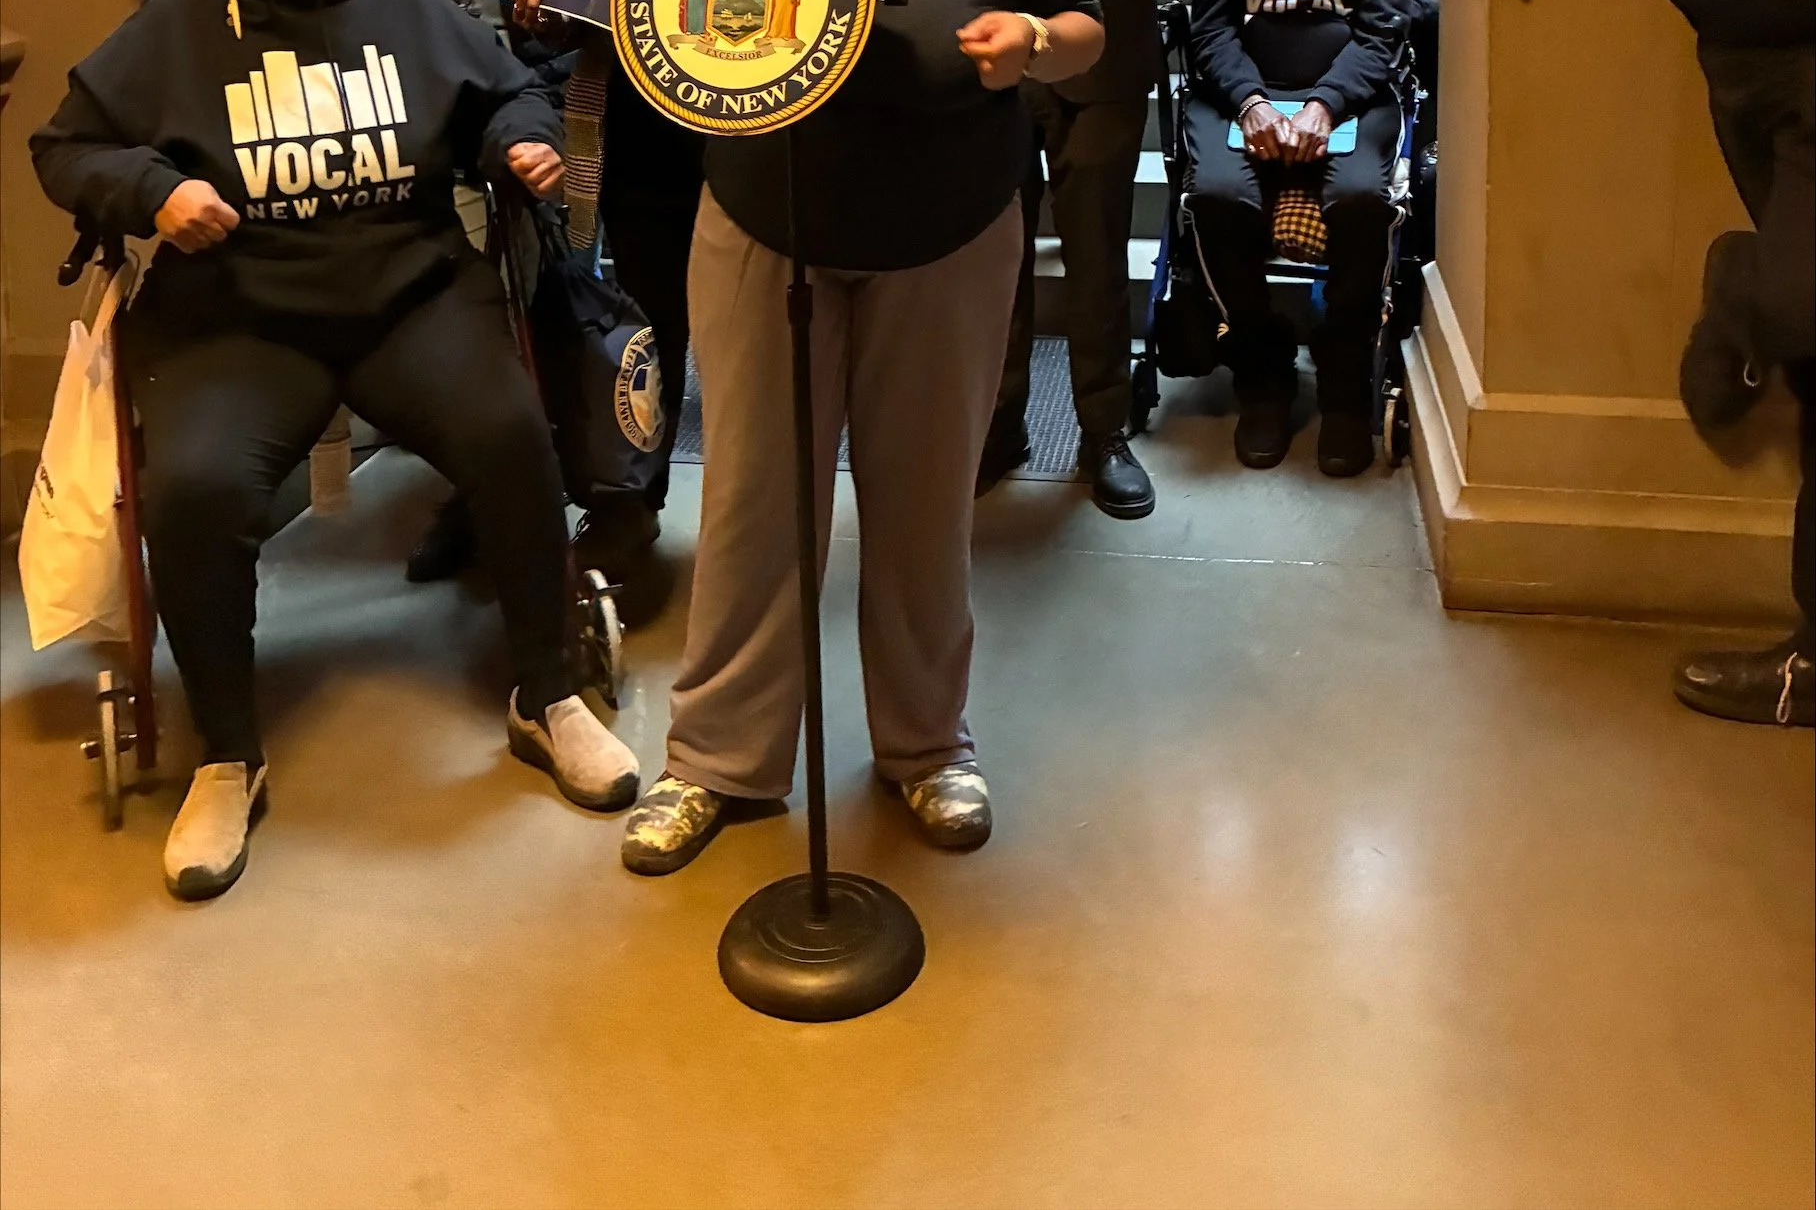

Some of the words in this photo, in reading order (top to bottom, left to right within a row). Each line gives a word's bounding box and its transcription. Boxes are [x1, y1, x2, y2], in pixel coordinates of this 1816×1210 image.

[630, 1, 678, 87] STATE
[676, 81, 718, 111] OF
[720, 82, 788, 115] NEW
[790, 8, 852, 90] YORK
[706, 46, 764, 61] EXCELSIOR
[234, 129, 416, 199] VOCAL
[246, 196, 319, 220] NEW
[331, 182, 415, 212] YORK
